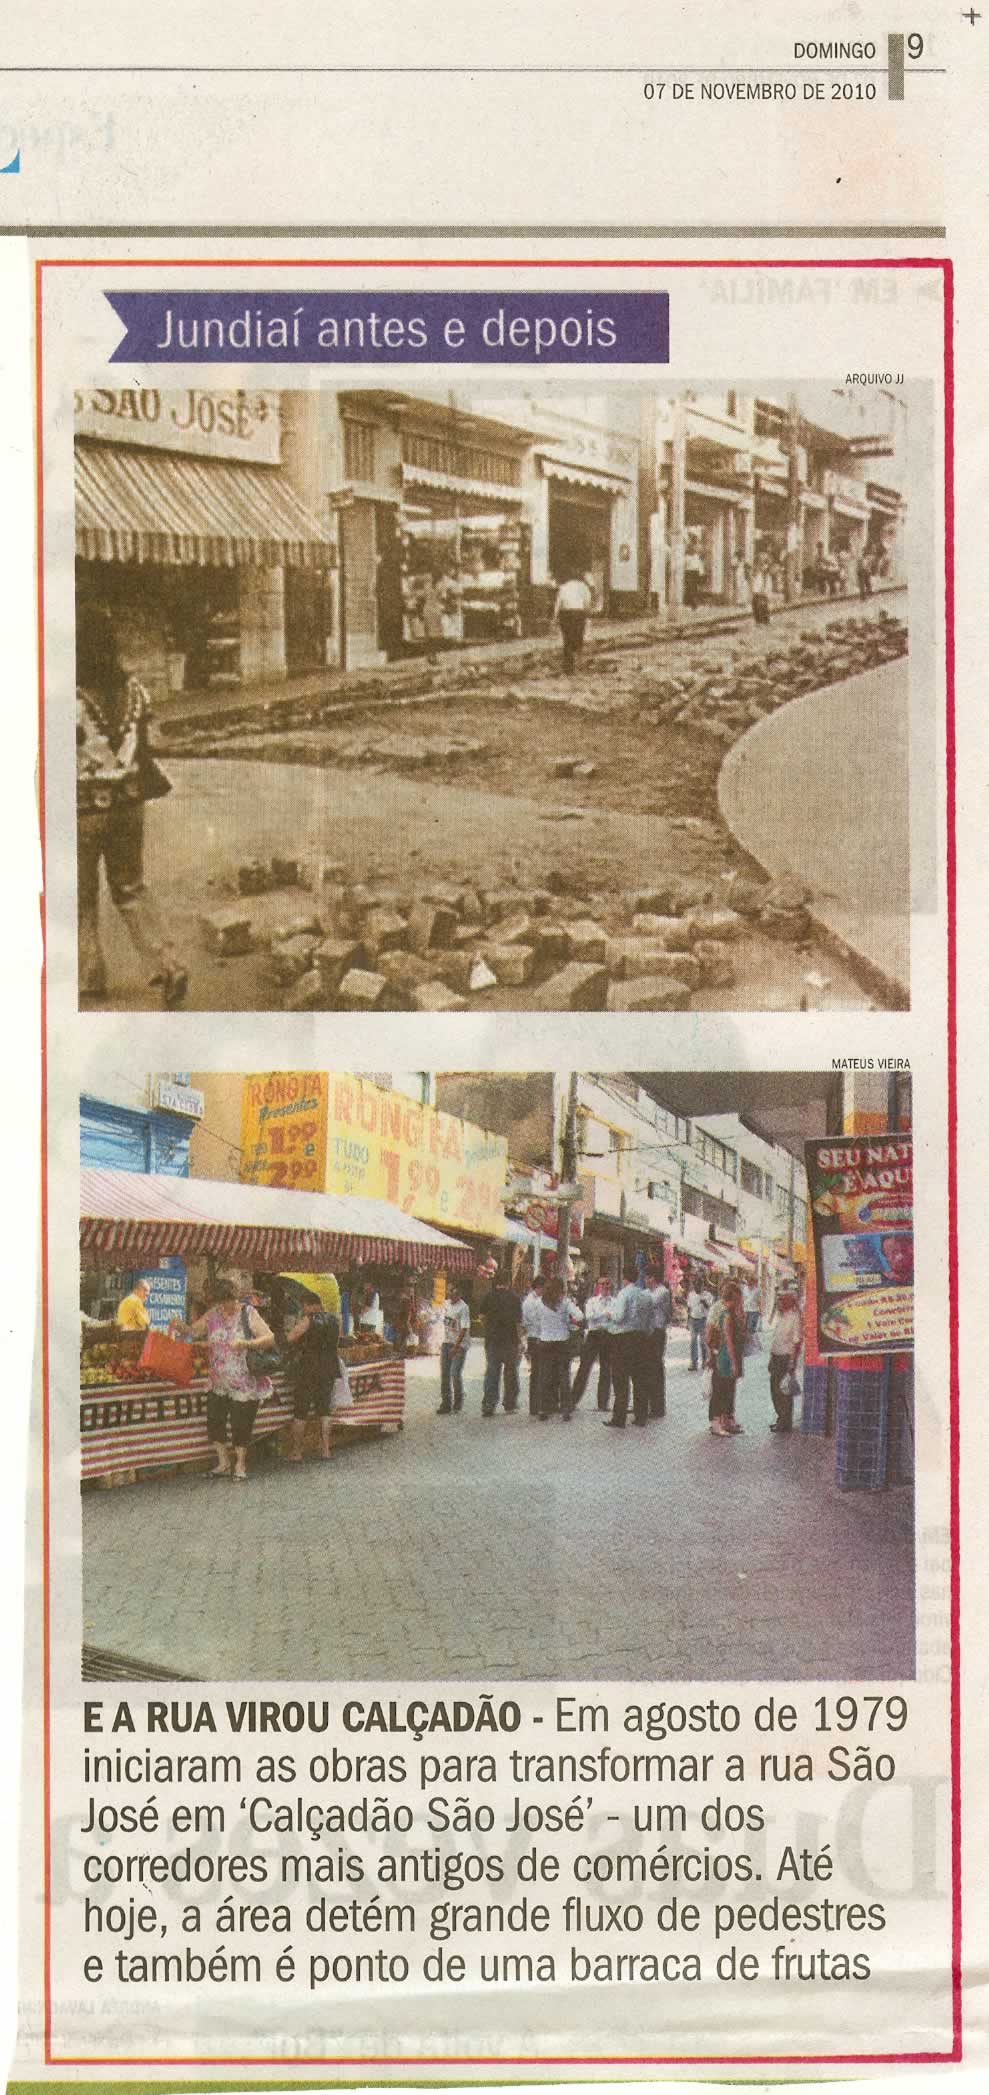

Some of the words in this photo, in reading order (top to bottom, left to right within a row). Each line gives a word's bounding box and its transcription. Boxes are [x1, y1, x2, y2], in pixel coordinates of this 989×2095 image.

[795, 43, 876, 59] DOMINGO
[907, 34, 924, 60] 9
[643, 83, 666, 100] 07
[672, 83, 695, 100] DE
[701, 83, 796, 100] NOVEMBRO
[803, 83, 825, 100] DE
[831, 83, 876, 100] 2010
[156, 306, 305, 349] Jundiaí
[317, 312, 428, 348] antes
[444, 318, 466, 348] e
[482, 308, 617, 355] depois
[845, 373, 893, 386] ARQUIVO
[895, 373, 905, 385] JJ
[831, 1058, 874, 1070] MATEUS
[877, 1058, 911, 1070] VIEIRA
[817, 1147, 860, 1169] SEU
[84, 1701, 104, 1733] E
[111, 1701, 136, 1733] A
[147, 1701, 217, 1733] RUA
[225, 1701, 329, 1733] VIROU
[342, 1693, 521, 1742] CALÇADÃO
[556, 1697, 609, 1732] Em
[623, 1699, 740, 1741] agosto
[754, 1696, 797, 1732] de
[815, 1696, 908, 1732] 1979
[84, 1748, 241, 1783] iniciaram
[256, 1755, 297, 1783] as
[309, 1747, 407, 1783] obras
[421, 1755, 497, 1791] para
[509, 1746, 714, 1783] transformar
[725, 1755, 745, 1782] a
[760, 1754, 813, 1782] rua
[828, 1745, 896, 1782] São
[80, 1795, 159, 1833] José
[172, 1805, 225, 1833] em
[427, 1796, 495, 1833] São
[634, 1805, 686, 1832] um
[701, 1796, 765, 1832] dos
[83, 1847, 268, 1883] corredores
[281, 1847, 365, 1883] mais
[377, 1847, 505, 1891] antigos
[517, 1847, 560, 1882] de
[573, 1844, 762, 1882] comércios.
[776, 1844, 833, 1881] Até
[85, 1896, 167, 1941] hoje,
[182, 1905, 201, 1933] a
[216, 1895, 291, 1933] área
[306, 1895, 415, 1933] detém
[429, 1896, 550, 1940] grande
[562, 1896, 644, 1932] fluxo
[657, 1896, 700, 1932] de
[715, 1896, 886, 1939] pedestres
[83, 1955, 103, 1983] e
[114, 1945, 261, 1983] também
[276, 1945, 295, 1982] é
[310, 1949, 409, 1991] ponto
[423, 1945, 466, 1982] de
[481, 1955, 555, 1982] uma
[571, 1945, 701, 1982] barraca
[716, 1945, 759, 1981] de
[771, 1945, 871, 1981] frutas
